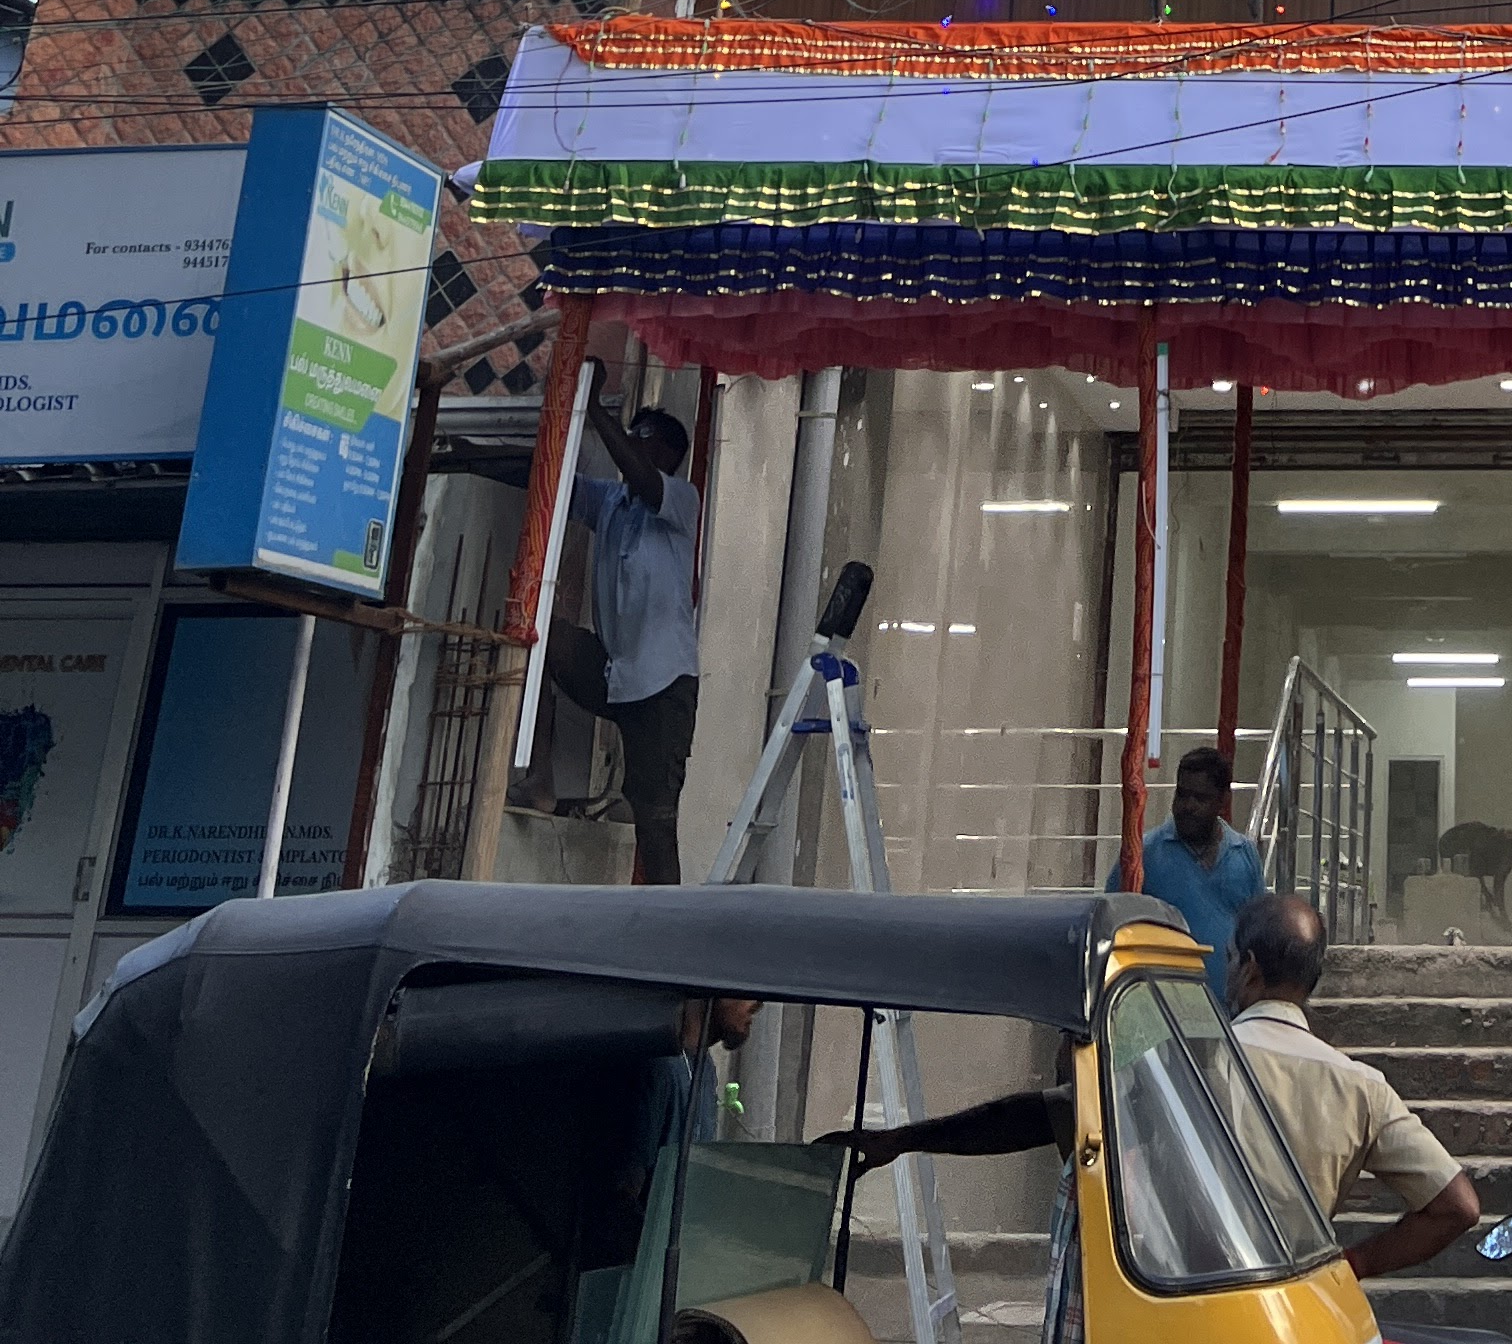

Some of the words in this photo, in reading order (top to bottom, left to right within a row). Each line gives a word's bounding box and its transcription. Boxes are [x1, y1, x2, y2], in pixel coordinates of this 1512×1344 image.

[85, 242, 109, 254] For
[112, 242, 171, 254] contacts
[183, 238, 232, 252] 934476
[0, 375, 32, 390] DS.
[142, 849, 255, 864] PERIODONTIST
